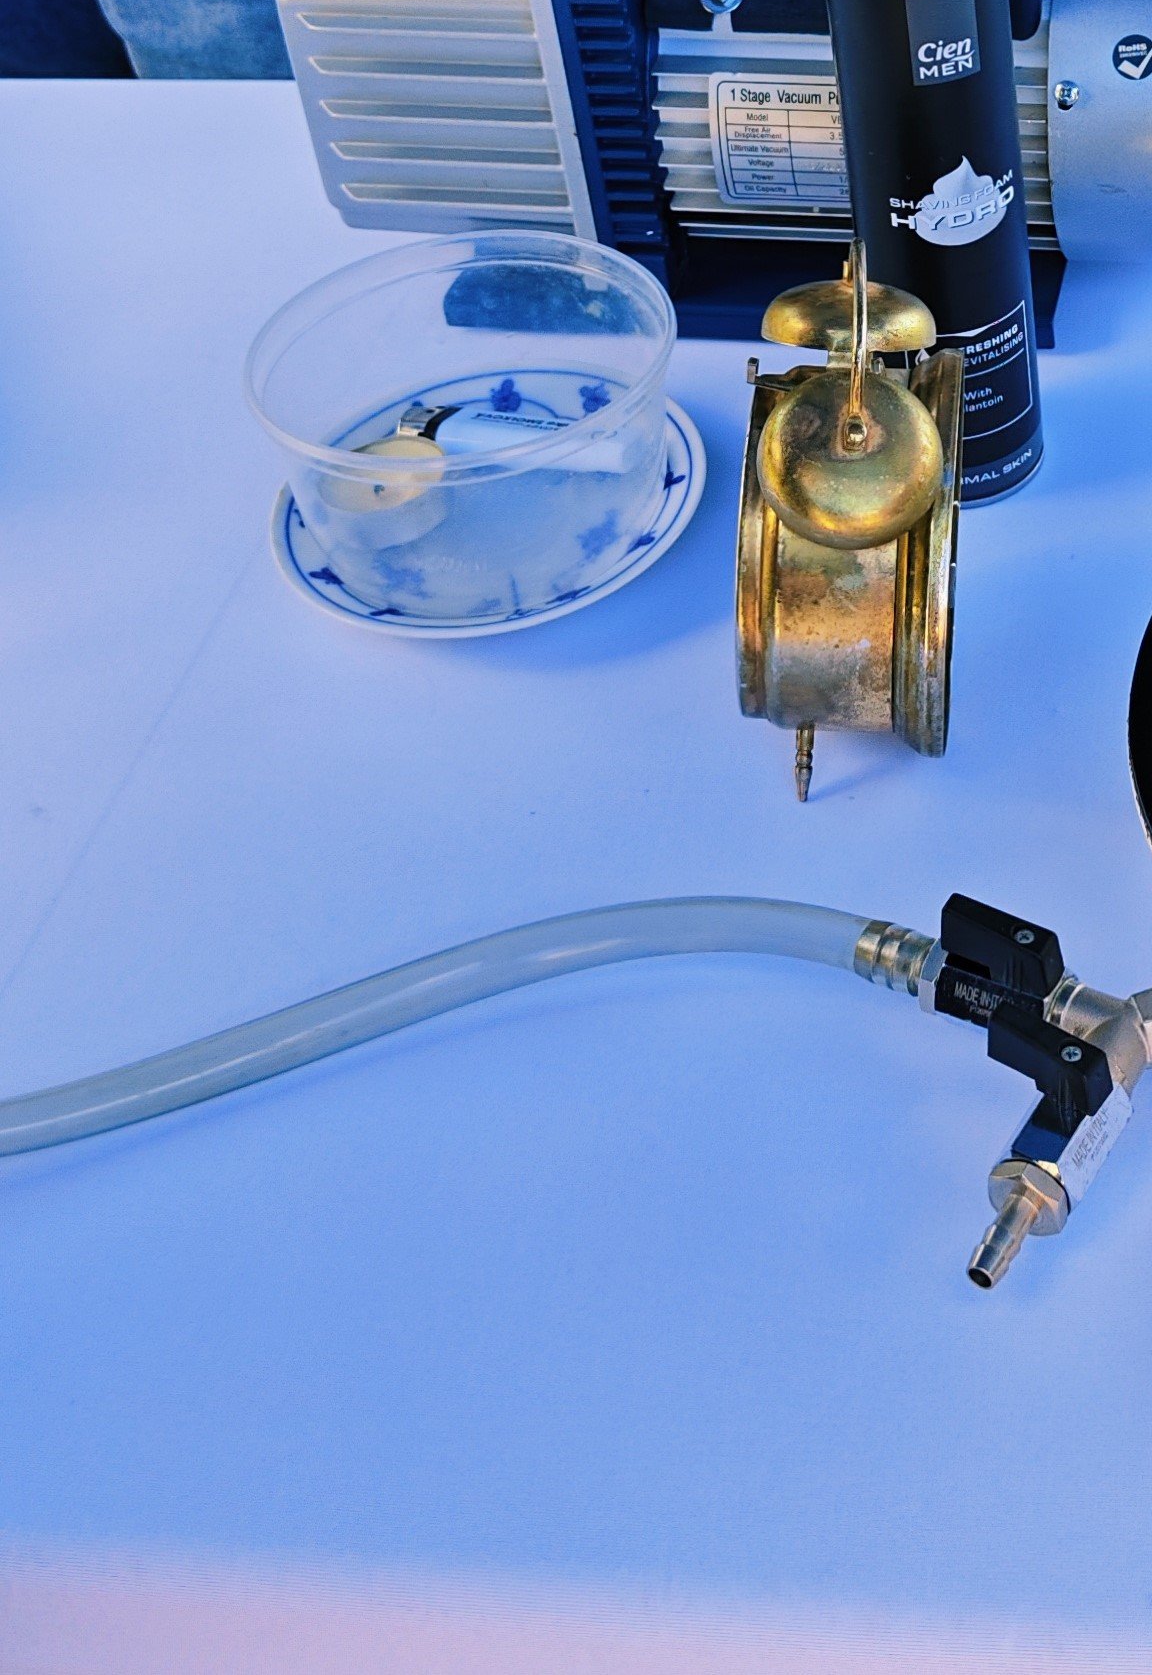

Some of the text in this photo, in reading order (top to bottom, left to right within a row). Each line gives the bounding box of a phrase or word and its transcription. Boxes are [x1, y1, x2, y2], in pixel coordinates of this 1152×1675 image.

[917, 37, 975, 63] Cien
[919, 56, 973, 80] MEN
[730, 88, 736, 101] 1
[740, 88, 771, 105] Stage
[777, 89, 822, 105] Vacuum
[746, 112, 769, 121] Model
[734, 131, 782, 140] Displacement
[760, 145, 789, 154] Vacuum
[748, 158, 774, 167] Voltage
[889, 169, 1013, 210] SHAVING FOAM
[890, 185, 1015, 230] HYDRO
[963, 394, 1004, 413] lantoin
[964, 387, 992, 401] With
[1002, 448, 1033, 475] SKIN
[954, 981, 980, 1007] MADE
